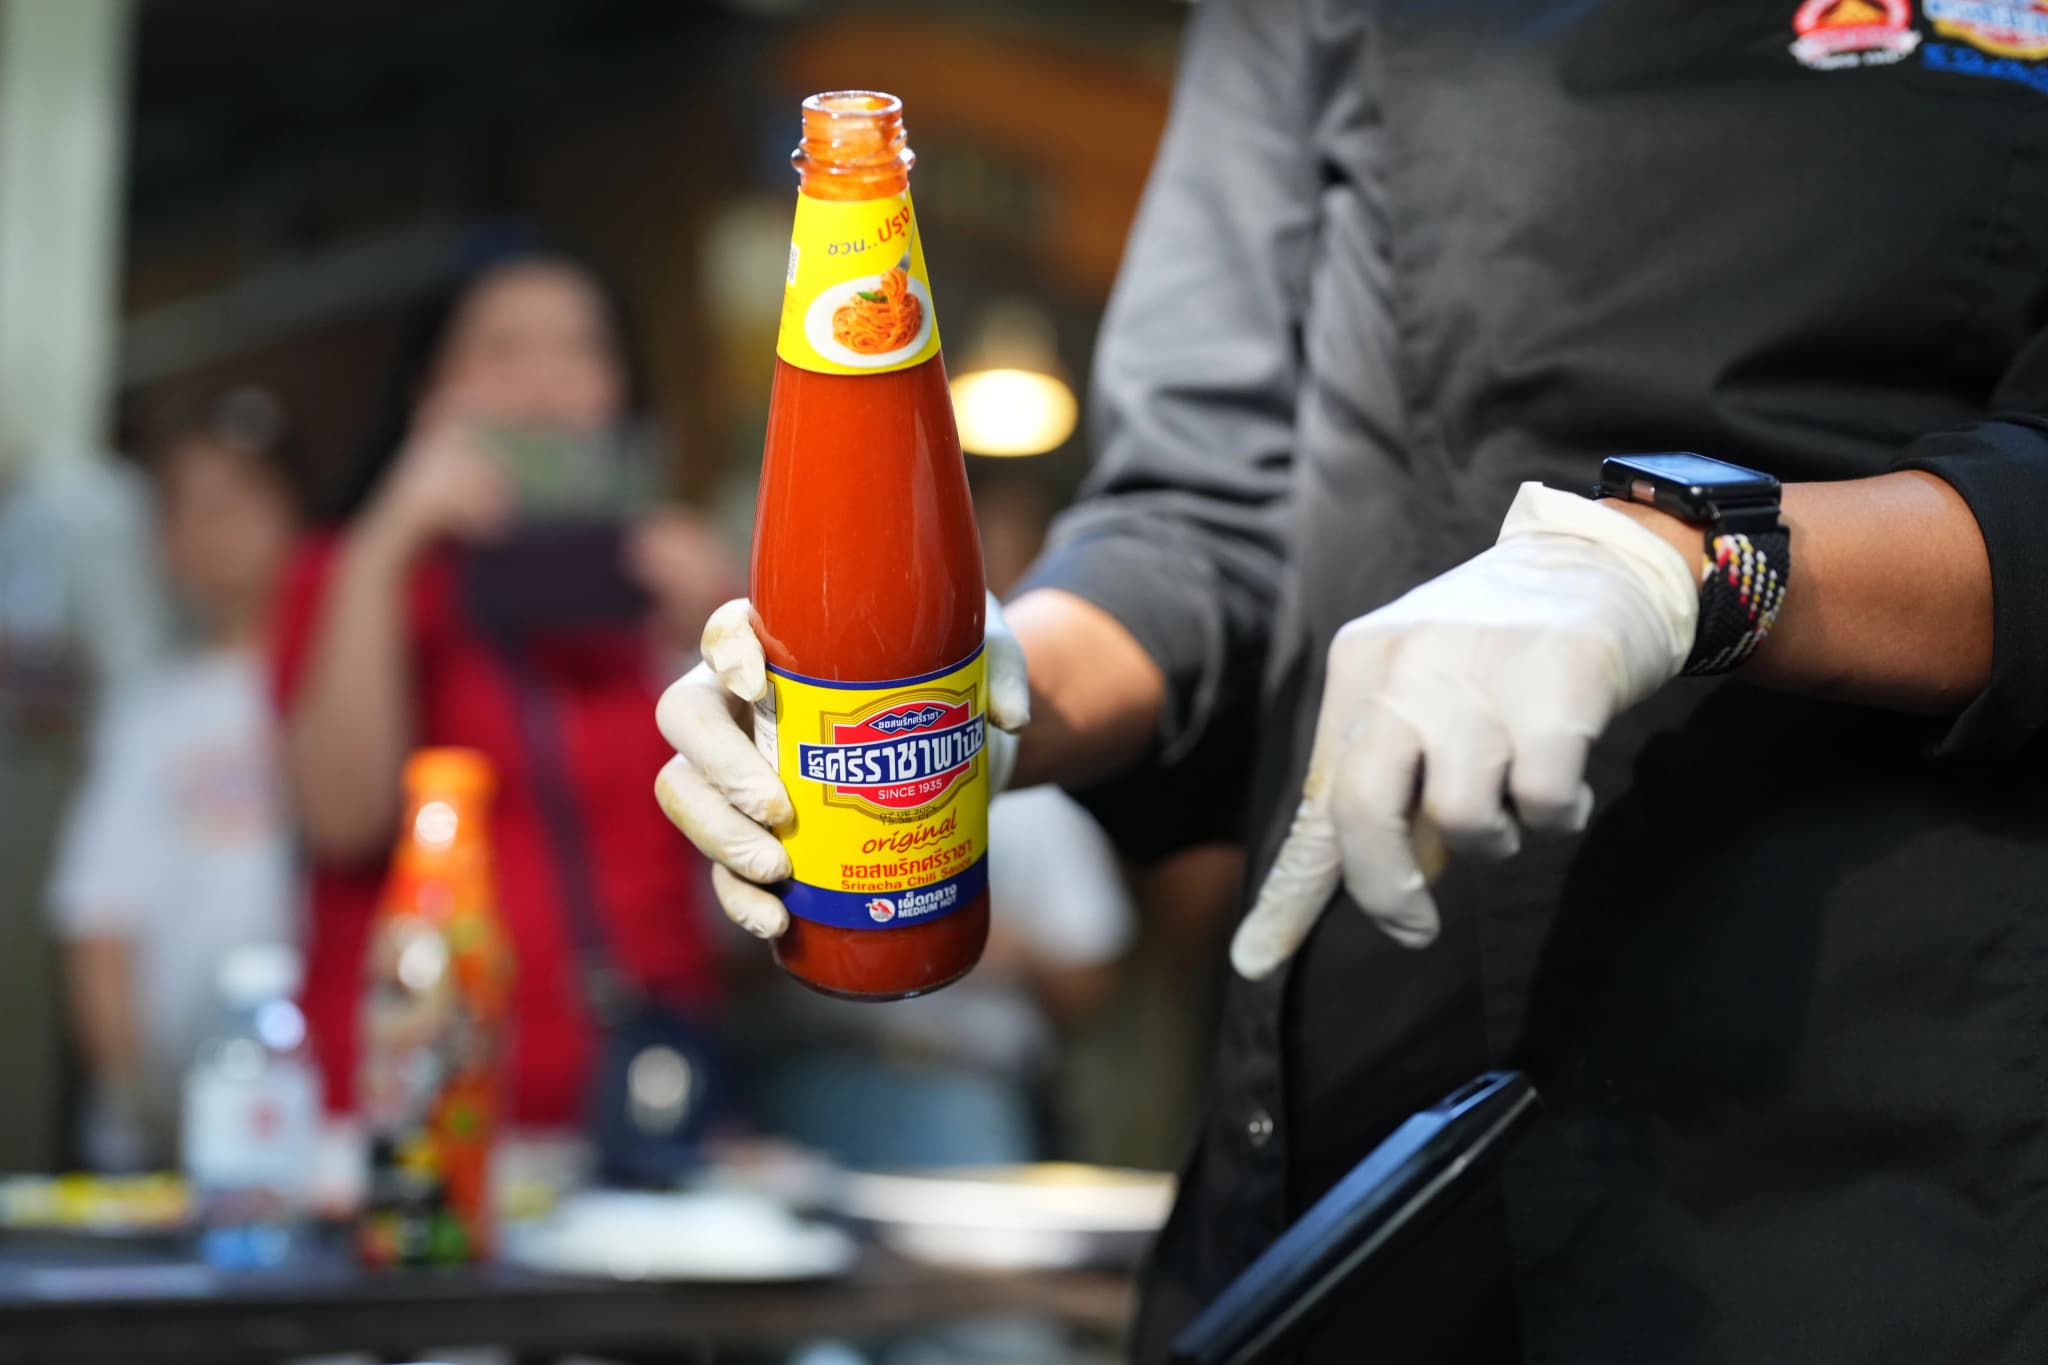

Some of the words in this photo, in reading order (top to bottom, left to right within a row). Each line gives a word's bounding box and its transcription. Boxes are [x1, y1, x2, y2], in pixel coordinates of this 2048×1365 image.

[825, 719, 984, 782] ศรีราชาพานิช
[878, 785, 916, 800] SINCE
[919, 779, 943, 793] 1935
[861, 807, 957, 854] original
[841, 839, 973, 879] ซอสพริกศรีราชา
[841, 879, 903, 891] Sriracha
[907, 872, 936, 887] Chili
[898, 884, 957, 909] เผ็ดกลาง
[898, 902, 938, 919] MEDIUM
[940, 894, 957, 909] HOT
